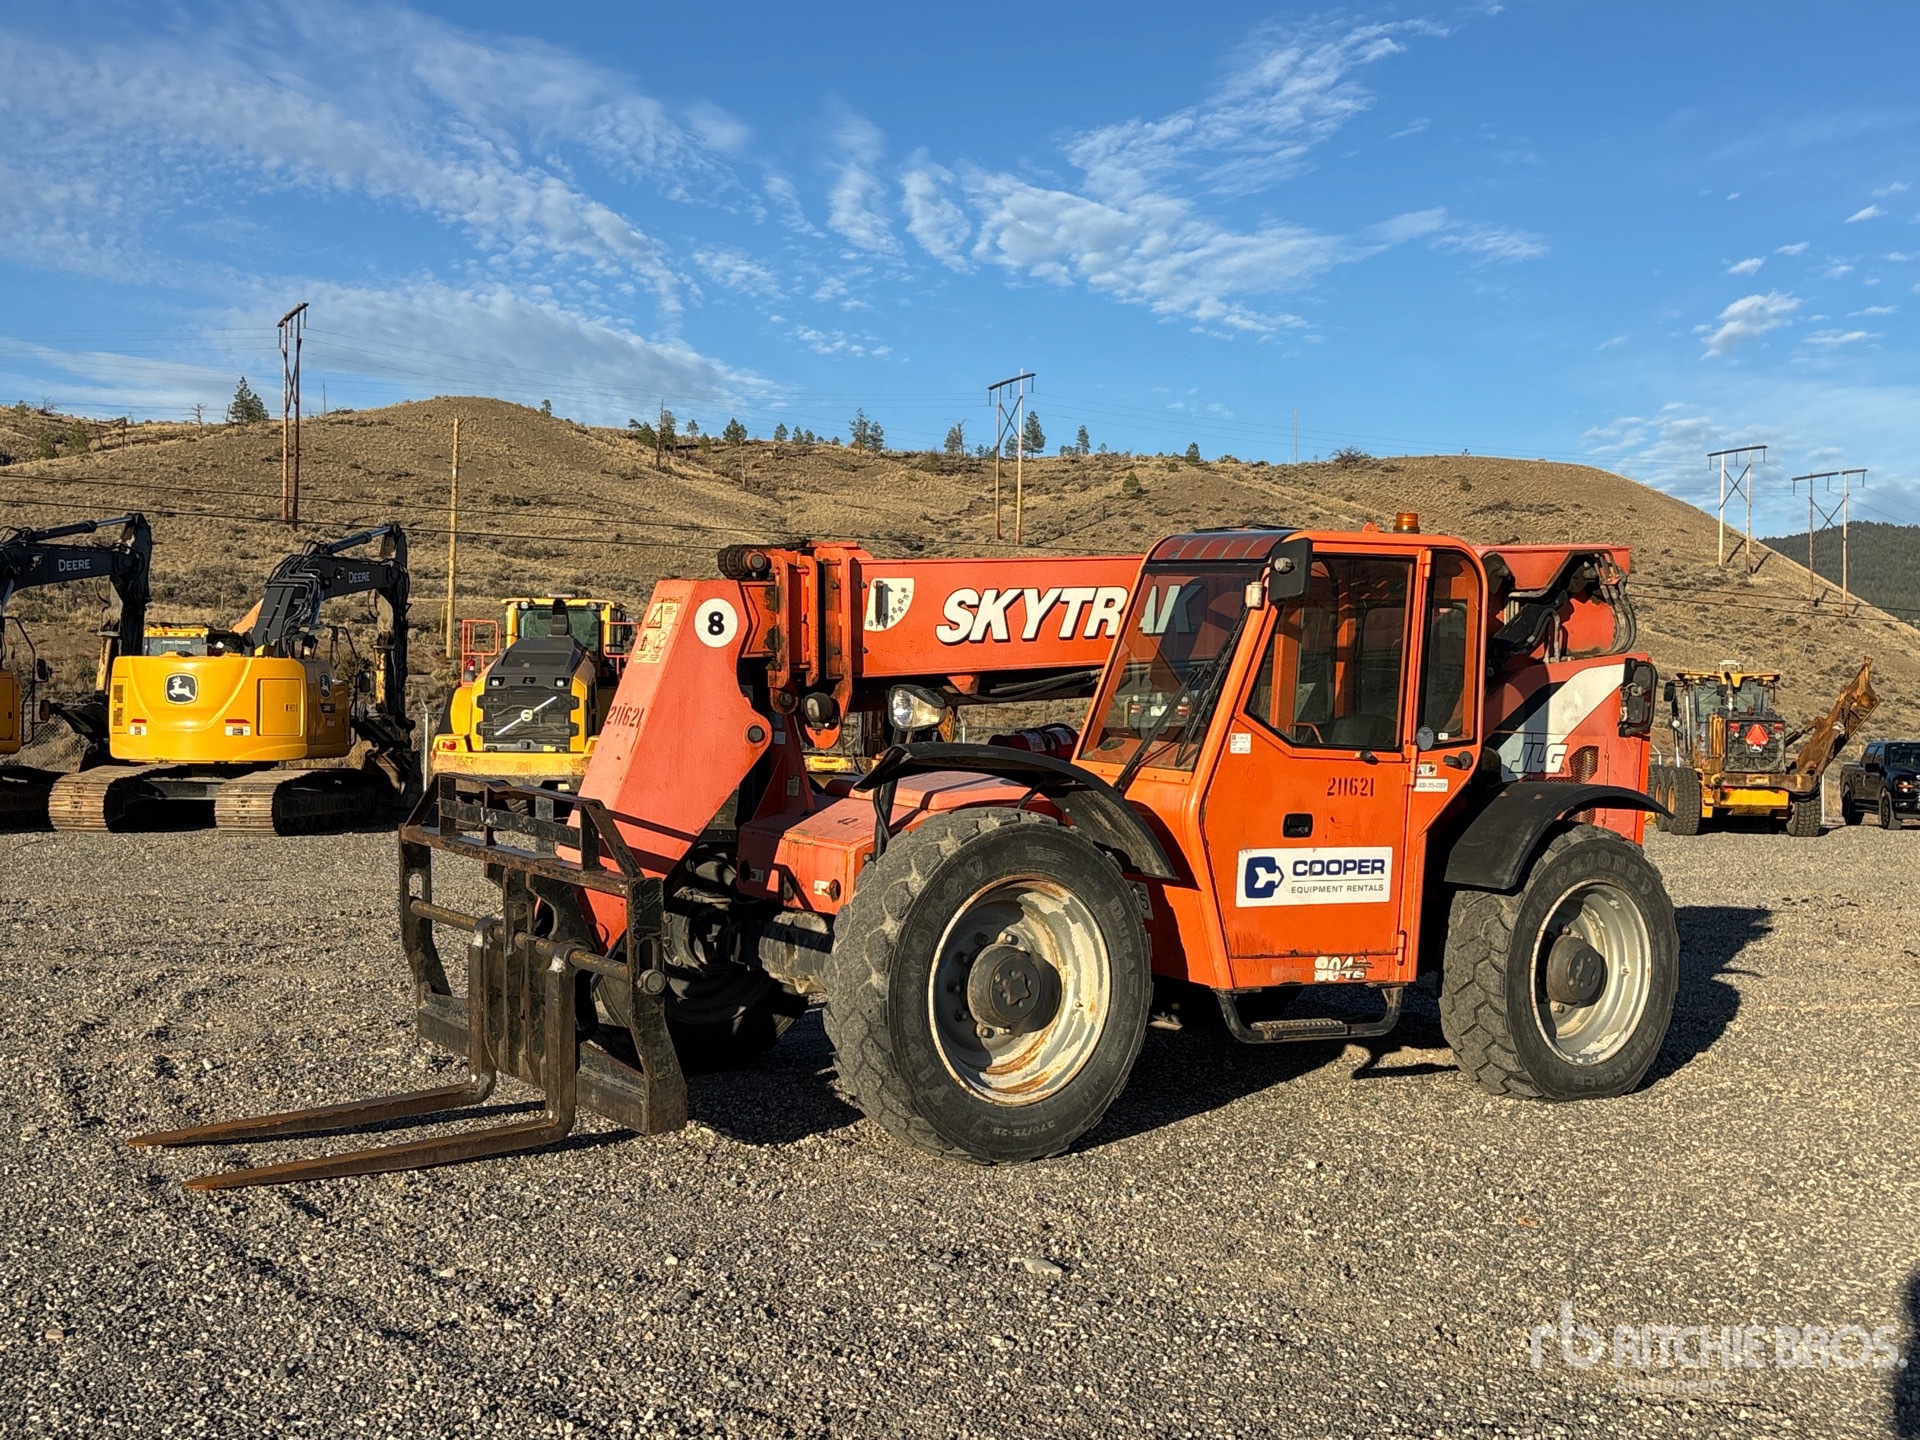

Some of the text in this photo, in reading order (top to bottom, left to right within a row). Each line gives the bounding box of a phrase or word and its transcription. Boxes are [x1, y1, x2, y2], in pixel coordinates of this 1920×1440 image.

[58, 559, 91, 572] DEERE
[348, 571, 371, 584] DEERE
[707, 610, 725, 636] 8
[606, 705, 645, 729] 211621
[1508, 742, 1569, 774] JLG
[1326, 777, 1375, 798] 211621
[1292, 859, 1386, 877] COOPER
[1290, 884, 1385, 894] EQUIPMENT RENTALS
